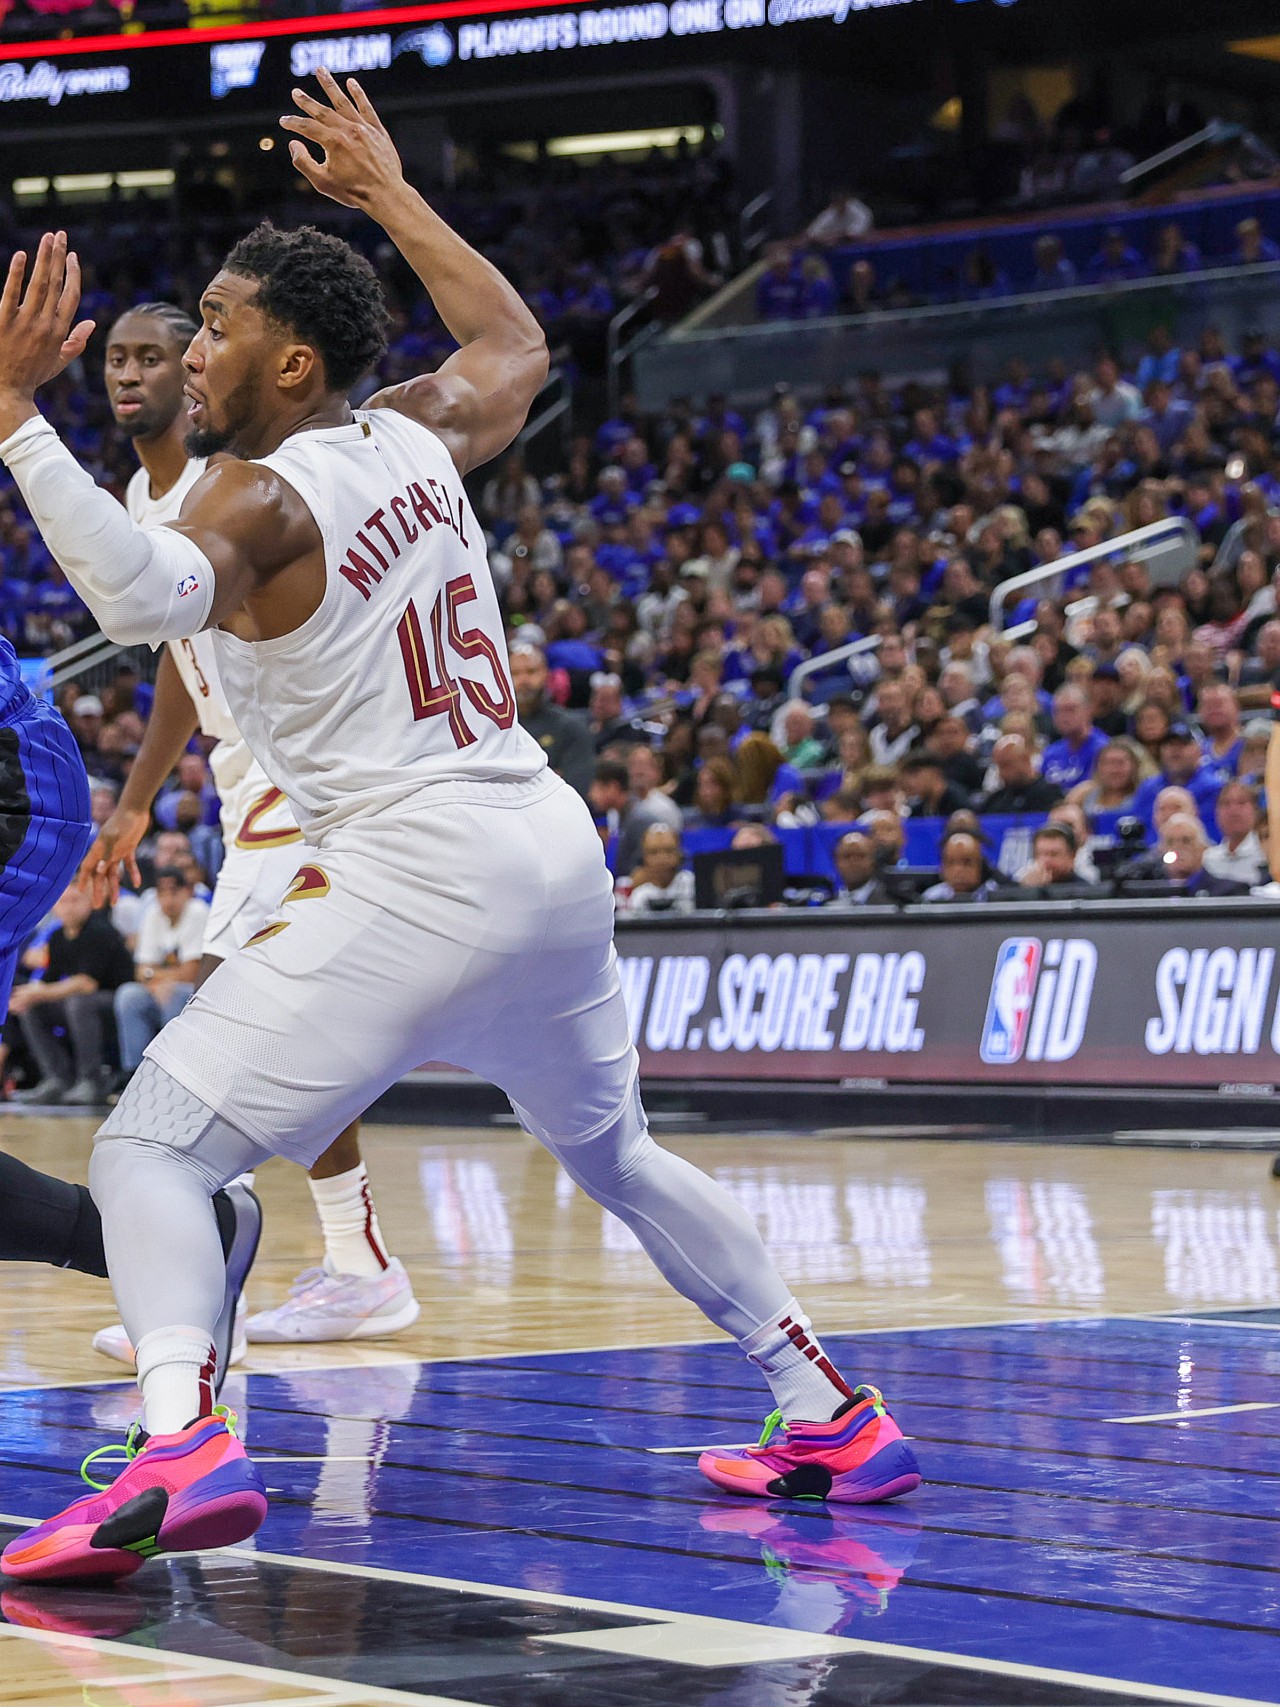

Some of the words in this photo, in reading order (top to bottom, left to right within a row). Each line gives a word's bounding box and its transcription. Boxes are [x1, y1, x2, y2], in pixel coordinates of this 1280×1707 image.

[290, 33, 392, 77] STREAM
[458, 12, 579, 61] PLAYOFFS
[578, 2, 669, 47] ROUND
[669, 0, 724, 36] ONE
[724, 0, 766, 30] ON
[338, 478, 469, 602] MITCHELL
[396, 572, 516, 750] 45
[645, 955, 711, 1051] UP.
[707, 952, 851, 1052] SCORE
[838, 950, 927, 1053] BIG.
[1144, 946, 1277, 1056] SIGN
